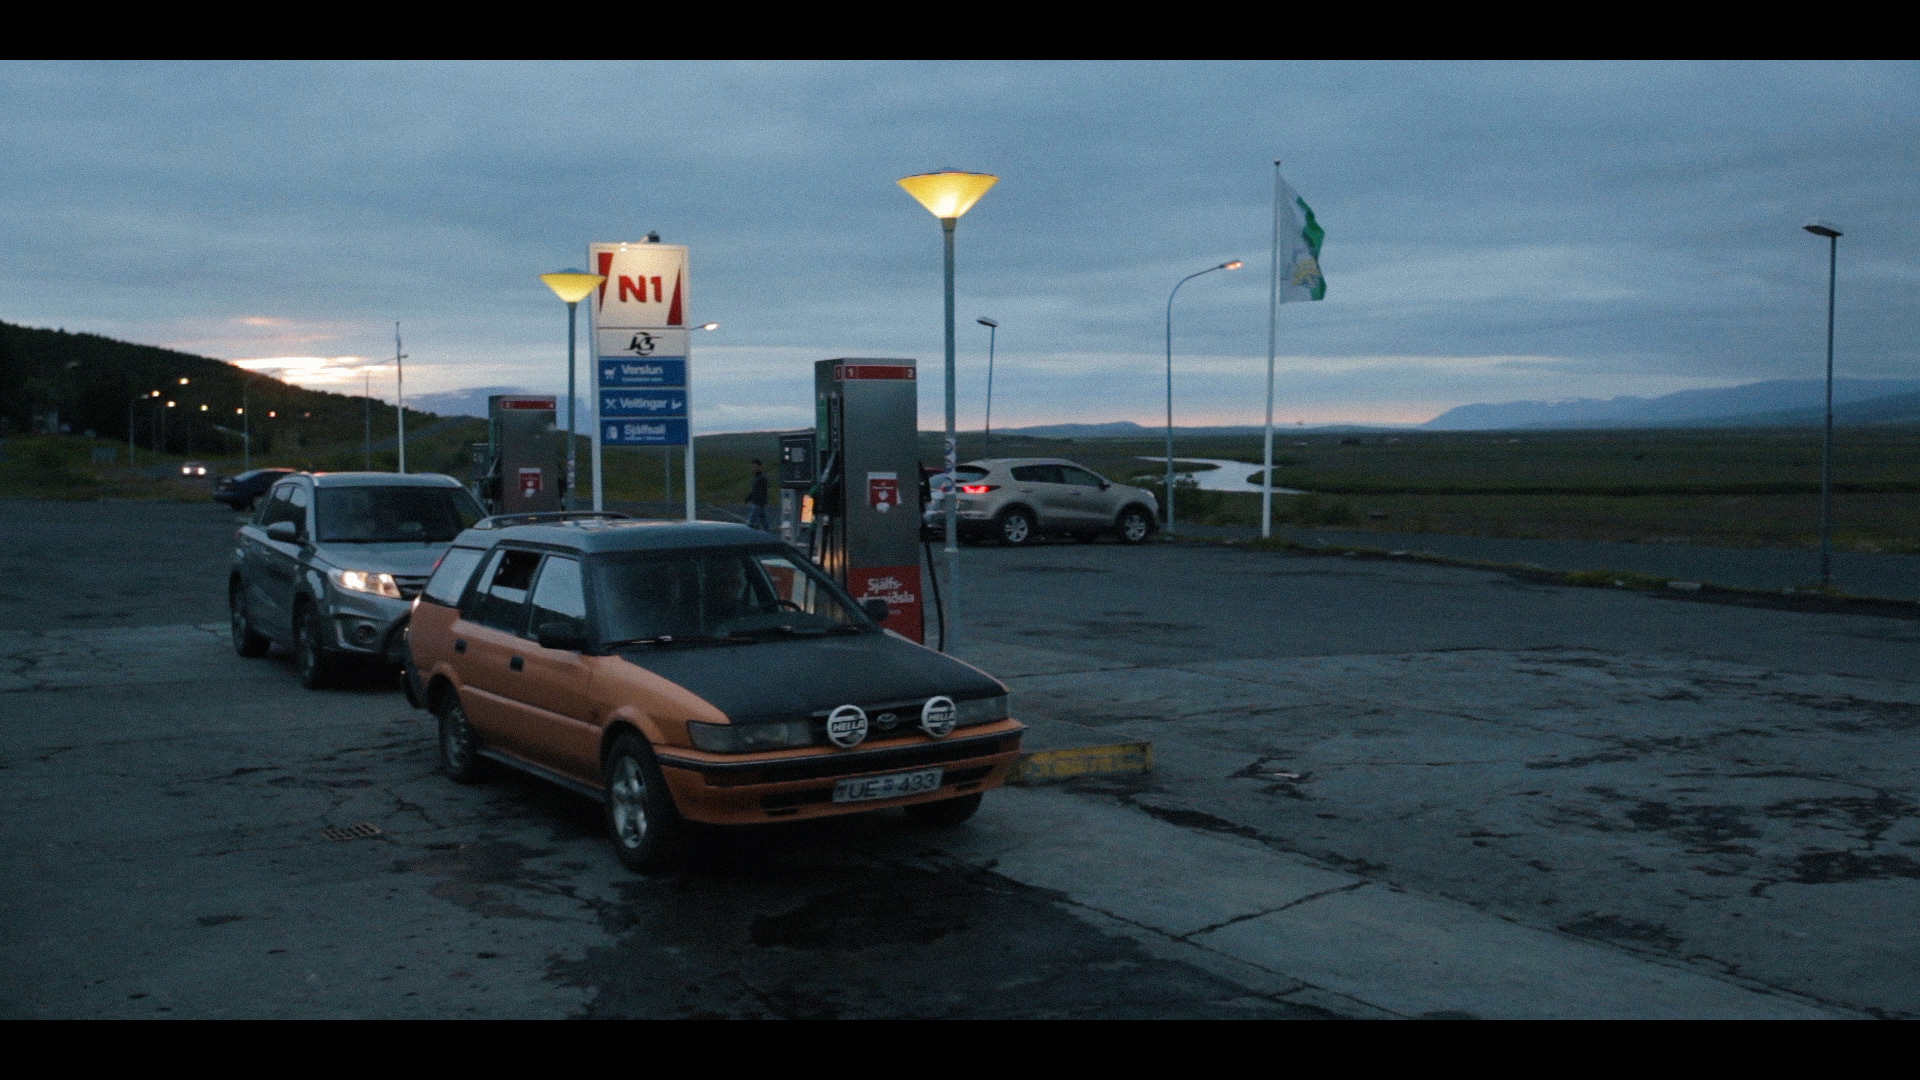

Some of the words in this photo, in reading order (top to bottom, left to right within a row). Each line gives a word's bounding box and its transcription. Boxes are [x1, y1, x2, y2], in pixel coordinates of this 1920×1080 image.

[618, 275, 663, 303] N1
[620, 365, 663, 375] Verslun
[848, 368, 854, 378] 1
[907, 368, 914, 378] 2
[619, 397, 667, 411] Veitingar
[833, 720, 865, 732] HELLA
[849, 780, 879, 799] UE
